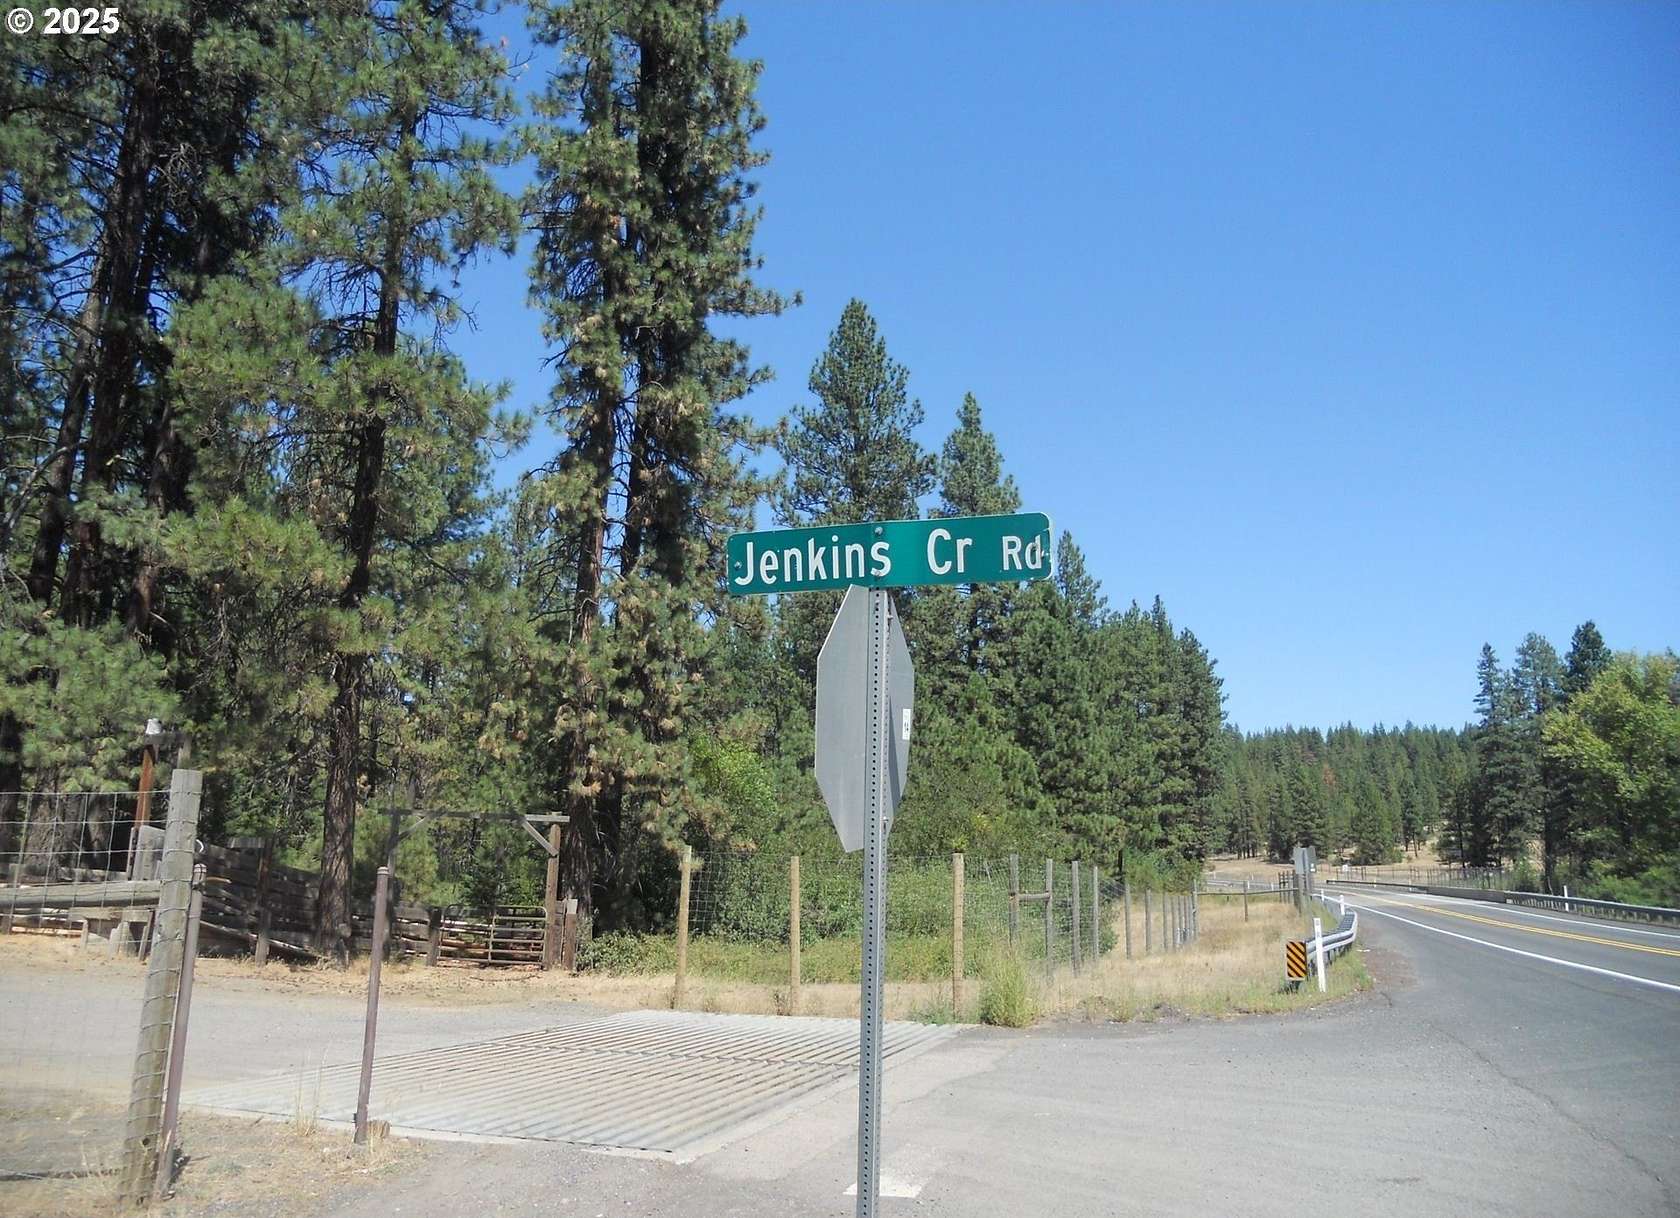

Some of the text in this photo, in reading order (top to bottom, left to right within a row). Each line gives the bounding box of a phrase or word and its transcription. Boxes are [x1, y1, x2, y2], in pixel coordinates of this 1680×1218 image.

[734, 528, 1042, 586] Jenkins Cr Rd
